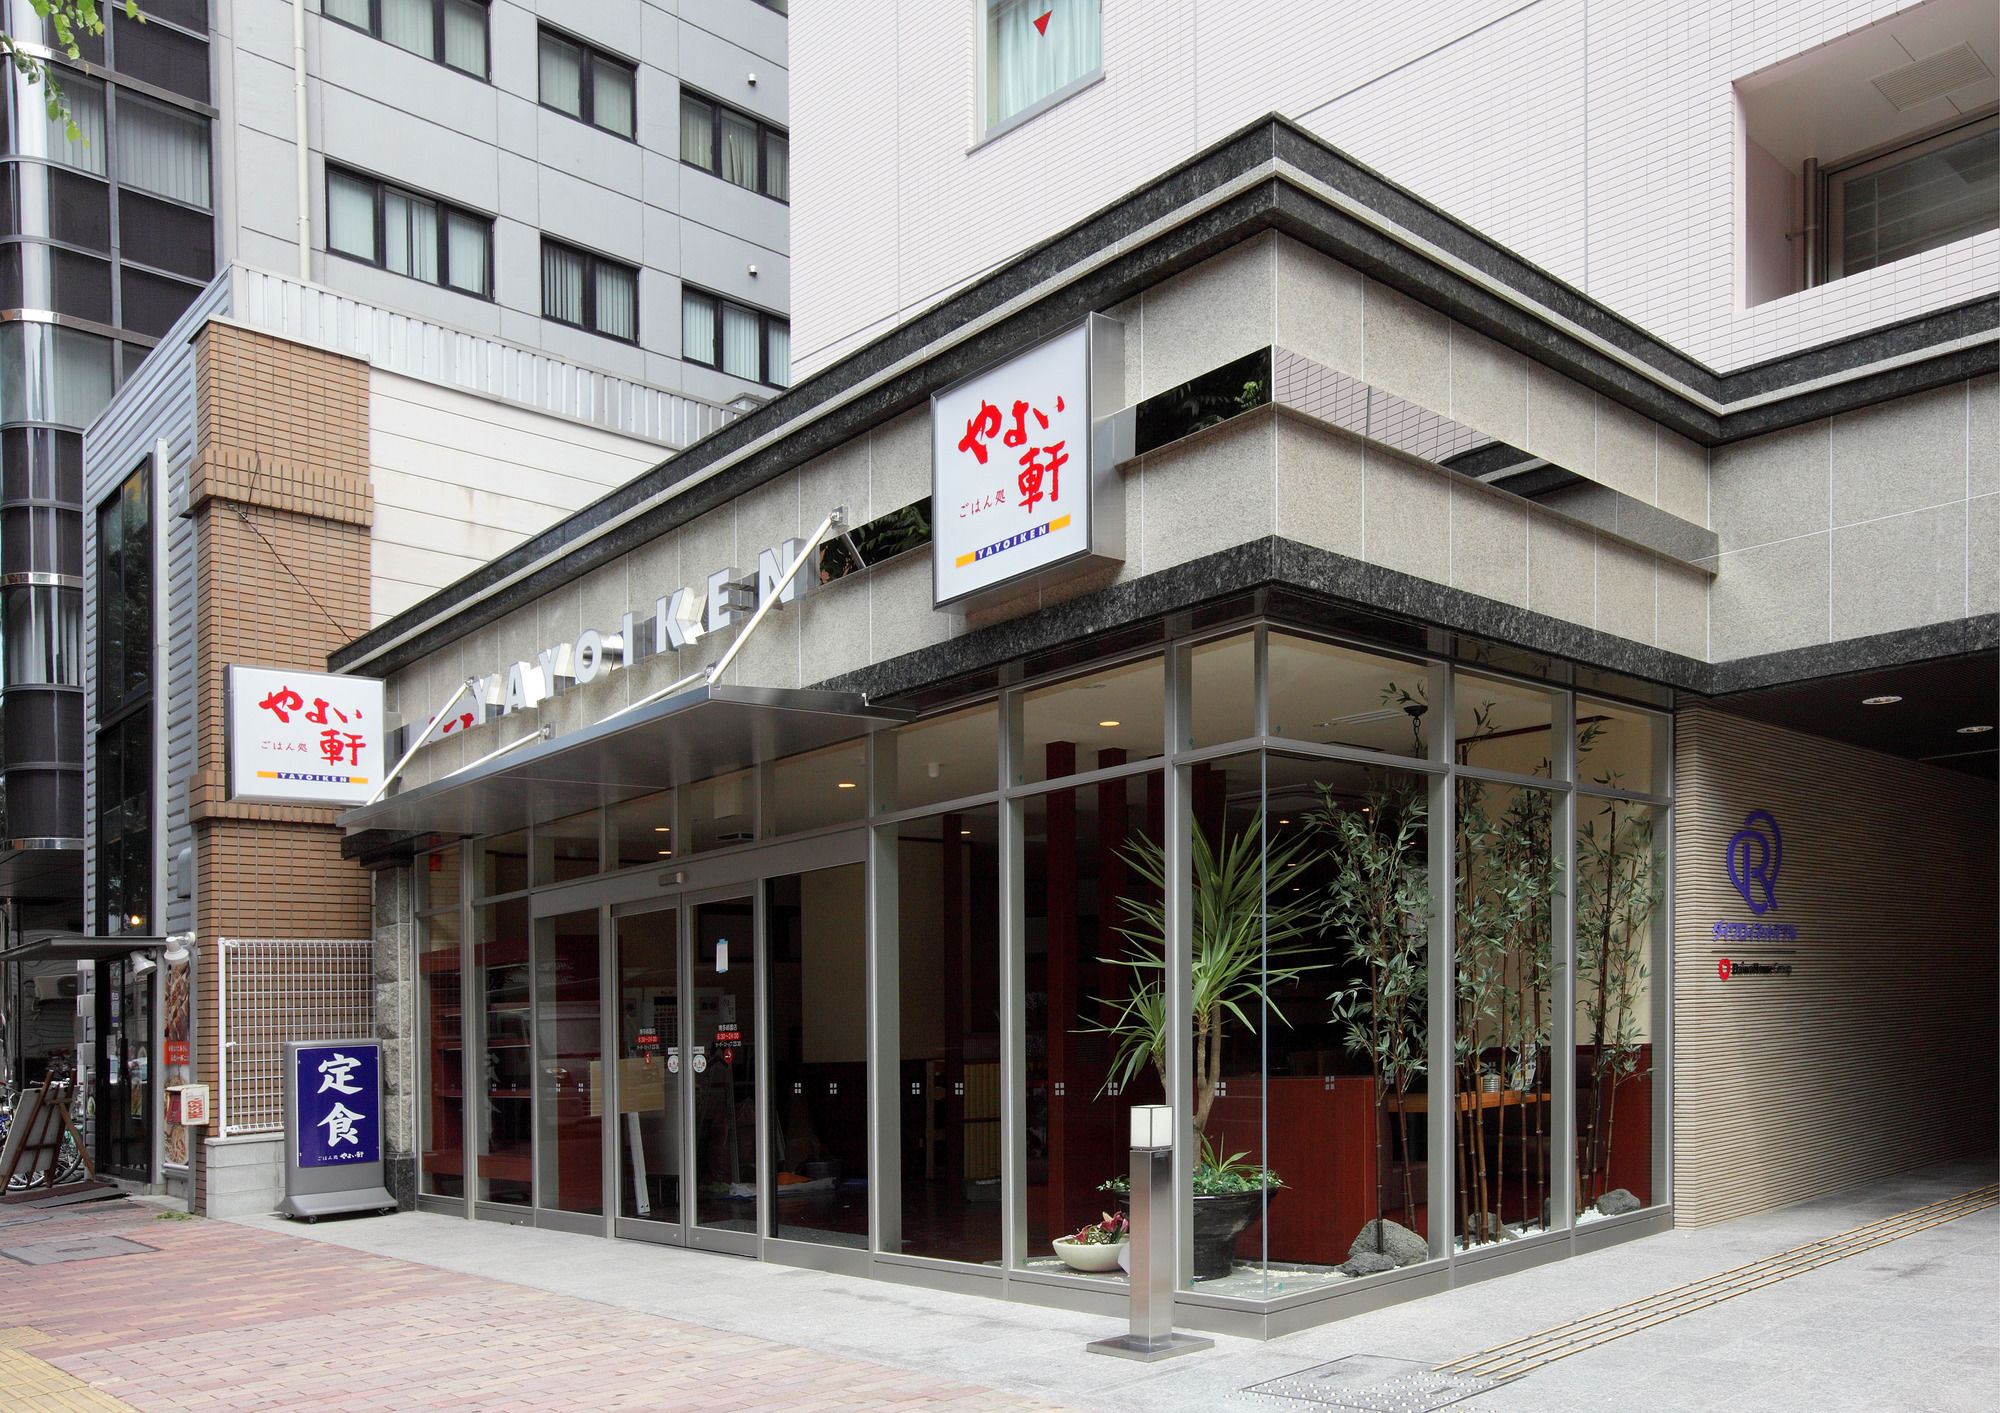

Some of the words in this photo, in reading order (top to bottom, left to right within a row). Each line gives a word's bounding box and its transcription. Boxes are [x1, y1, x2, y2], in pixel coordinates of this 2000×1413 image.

[957, 395, 1066, 465] やよい
[1017, 440, 1070, 514] 軒
[959, 488, 1007, 518] ごはん処
[976, 523, 1048, 560] YAYOIKEN
[472, 537, 800, 725] YAYOIKEN
[258, 684, 363, 725] やよい
[260, 739, 309, 753] ごはん処
[319, 728, 367, 767] 軒
[280, 772, 348, 783] YAYOIKEN
[316, 1052, 367, 1148] 定食
